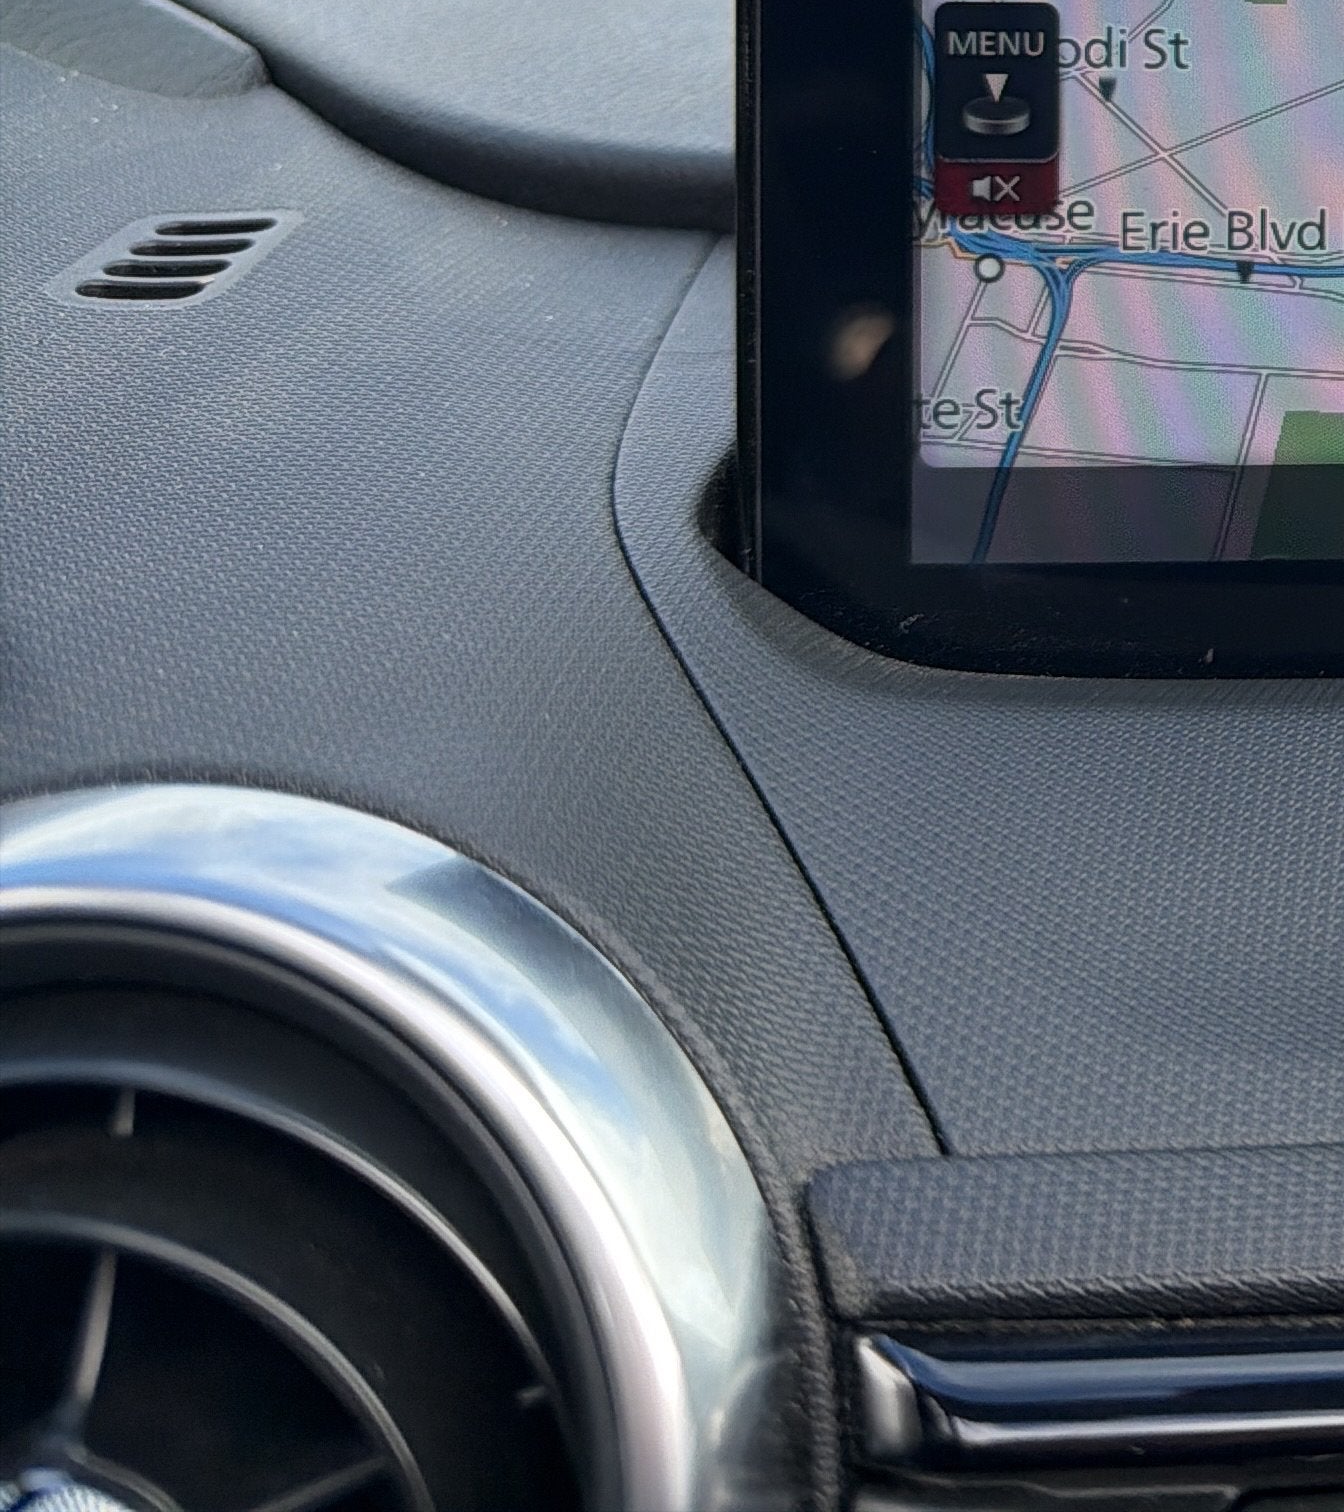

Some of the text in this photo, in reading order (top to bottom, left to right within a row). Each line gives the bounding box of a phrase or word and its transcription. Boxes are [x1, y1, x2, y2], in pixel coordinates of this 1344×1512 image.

[948, 31, 1044, 56] MENU
[1144, 28, 1189, 70] St
[1122, 213, 1210, 251] Erie
[1227, 210, 1330, 251] Blvd
[976, 389, 1021, 429] St
